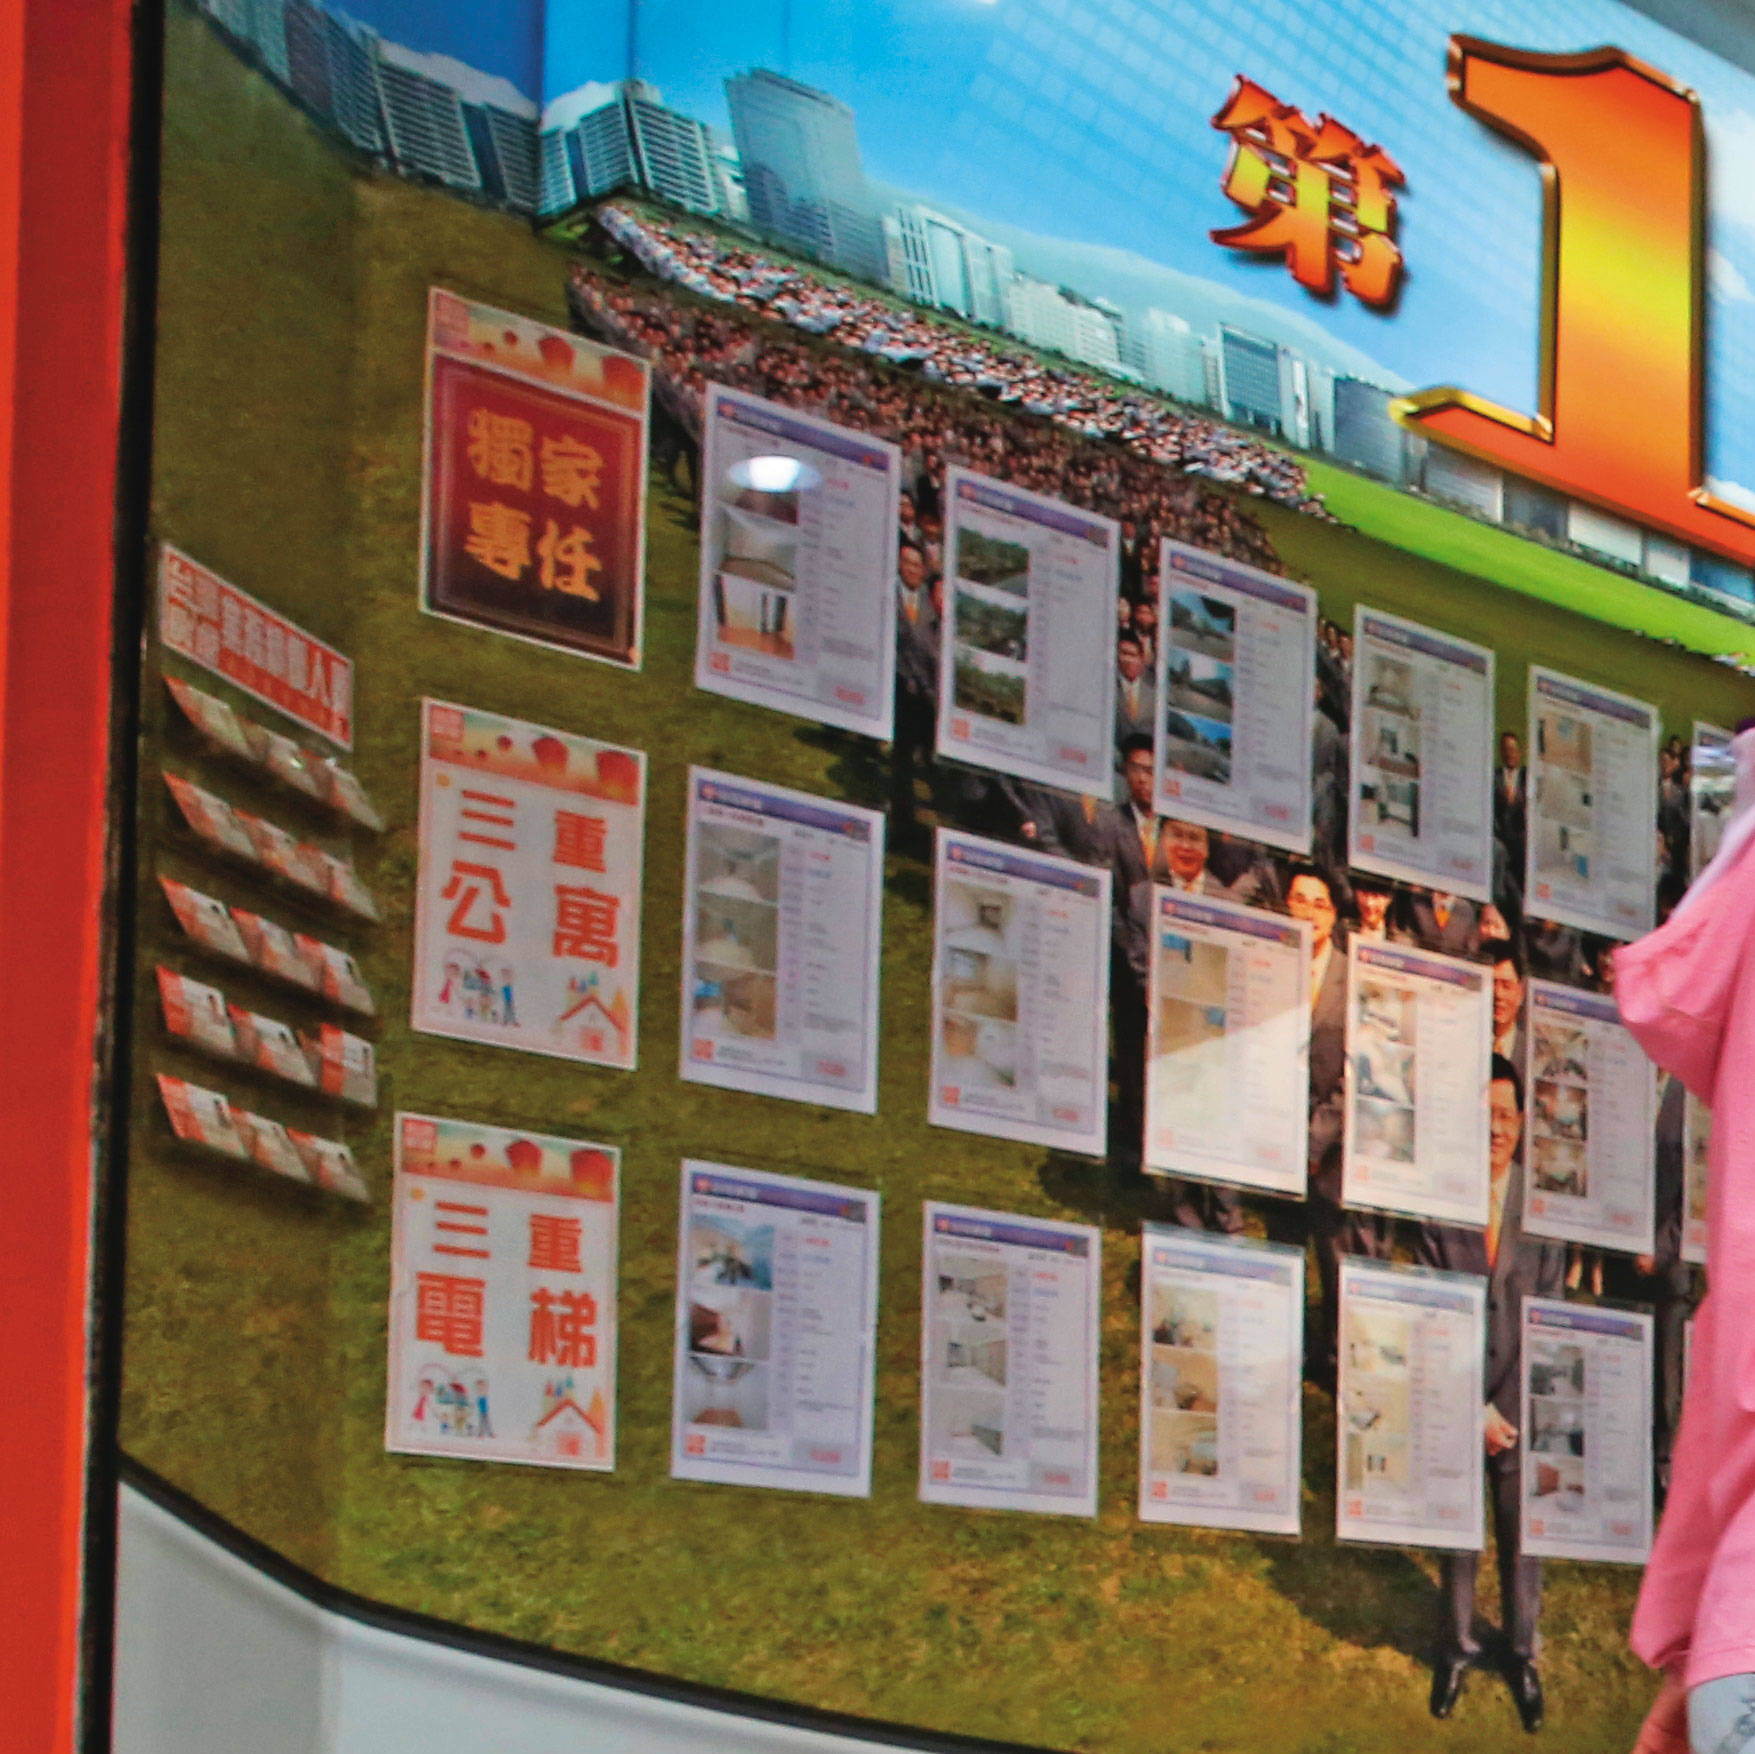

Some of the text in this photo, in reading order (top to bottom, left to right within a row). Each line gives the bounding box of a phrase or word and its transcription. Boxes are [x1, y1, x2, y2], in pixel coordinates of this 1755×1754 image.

[466, 408, 604, 511] 獨家
[463, 501, 602, 602] 專任
[457, 788, 609, 875] 三重
[440, 860, 623, 971] 公寓
[431, 1200, 586, 1275] 三重
[414, 1271, 599, 1370] 電梯
